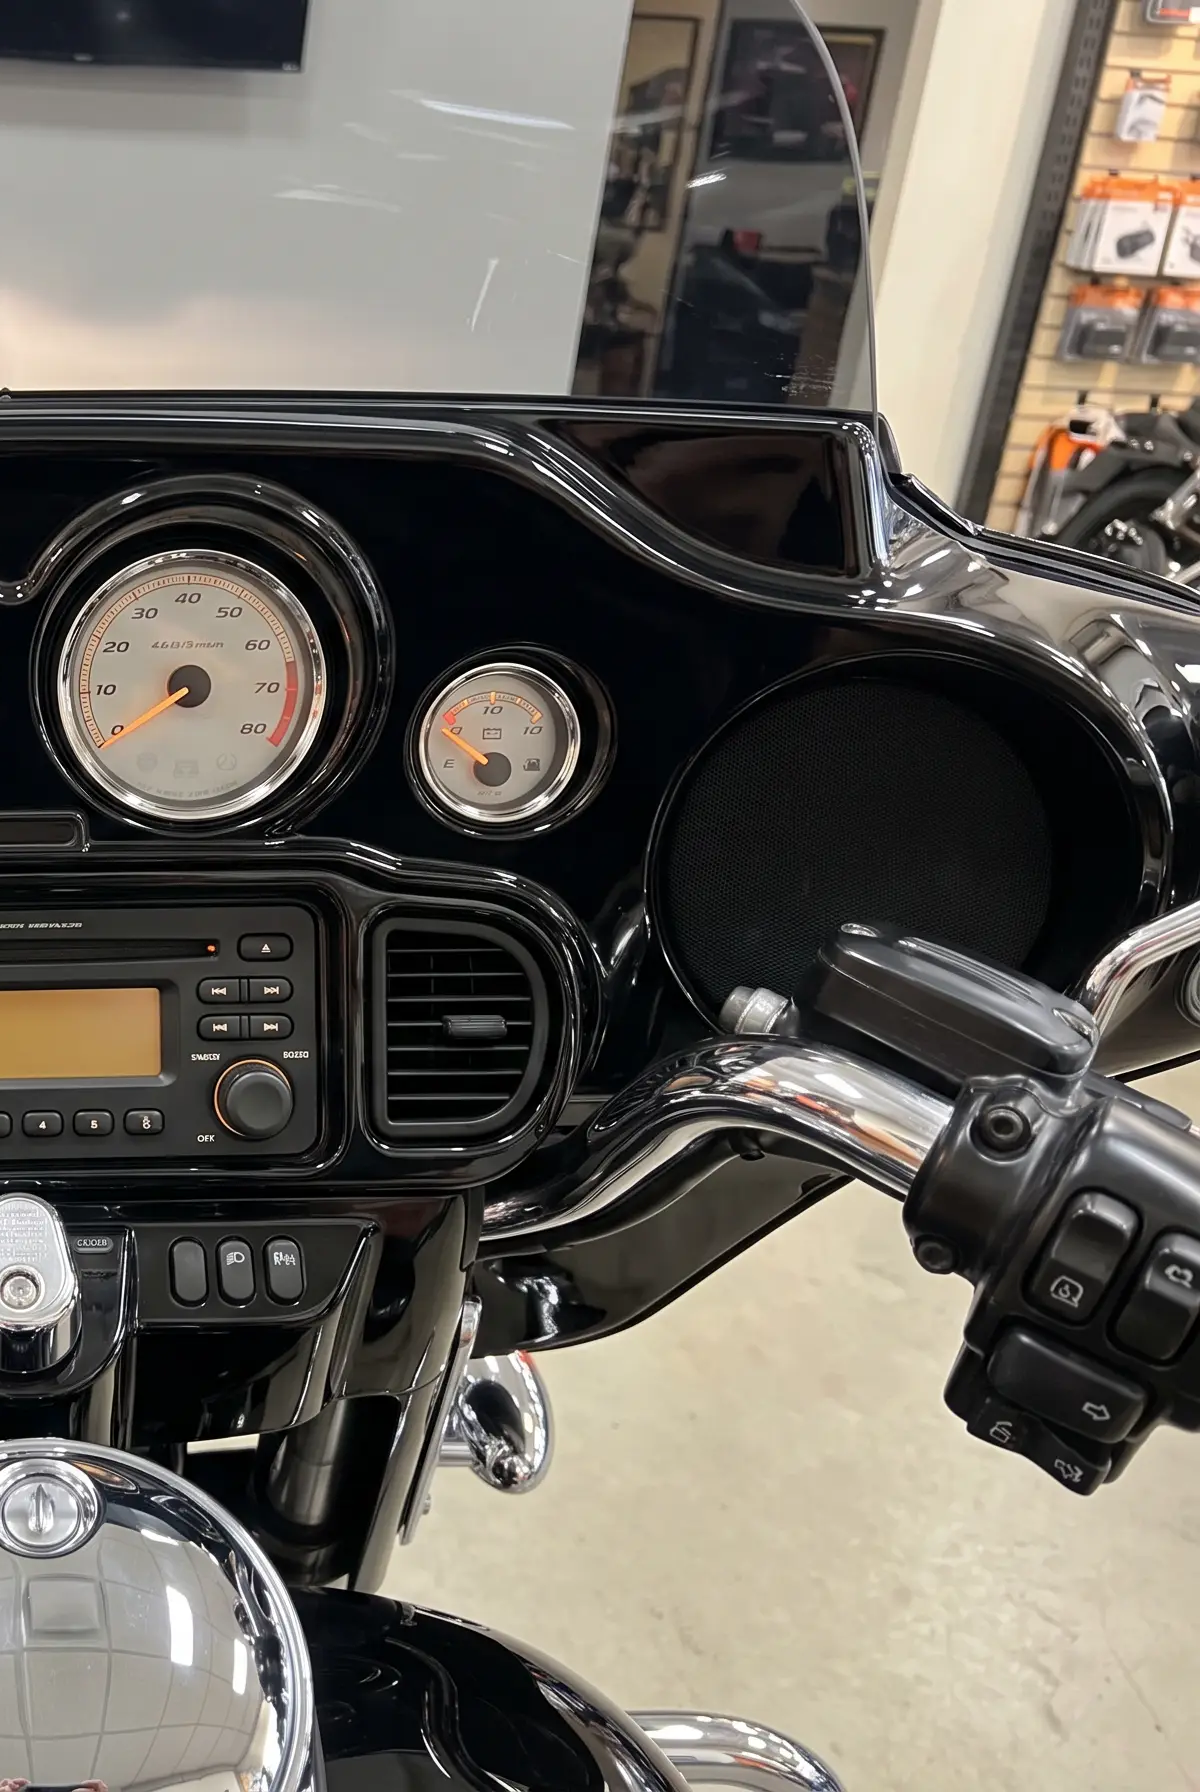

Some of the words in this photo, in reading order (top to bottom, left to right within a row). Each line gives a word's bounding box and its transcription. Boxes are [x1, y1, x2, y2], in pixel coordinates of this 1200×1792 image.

[174, 593, 202, 604] 40
[131, 608, 159, 619] 30
[215, 606, 243, 618] 50
[102, 641, 130, 652] 20
[244, 639, 271, 651] 60
[96, 684, 117, 696] 10
[254, 682, 280, 693] 70
[482, 706, 503, 715] 10
[111, 724, 124, 736] 0
[240, 723, 267, 734] 80
[523, 726, 543, 735] 10
[443, 759, 455, 768] E
[39, 1121, 47, 1130] 4
[90, 1120, 98, 1129] 5
